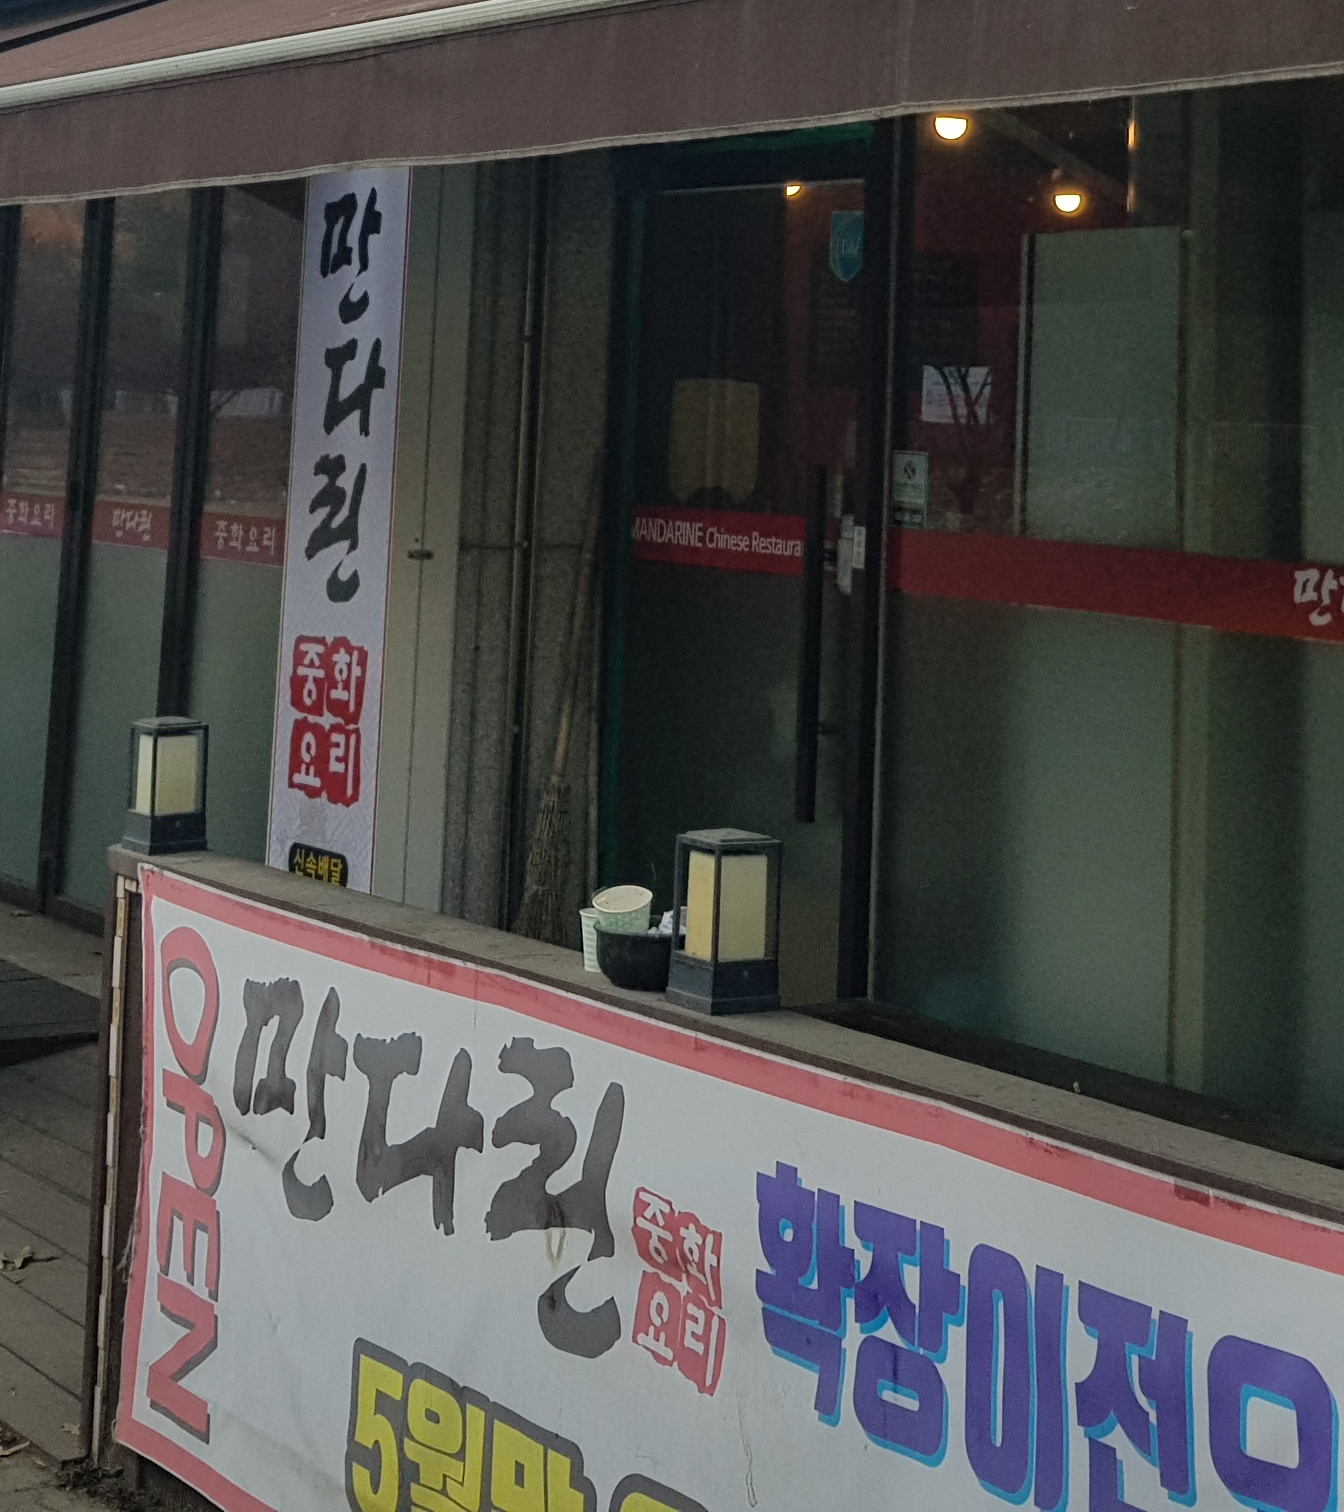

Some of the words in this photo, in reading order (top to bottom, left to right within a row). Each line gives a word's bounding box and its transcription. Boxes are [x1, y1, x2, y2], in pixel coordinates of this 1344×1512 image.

[304, 186, 388, 604] 만다린
[5, 497, 56, 529] 중화요리
[214, 519, 277, 556] 중화요리
[705, 526, 750, 552] Chinese
[293, 848, 343, 886] 신속배달
[146, 926, 227, 1443] OPEN
[233, 977, 625, 1358] 만다린
